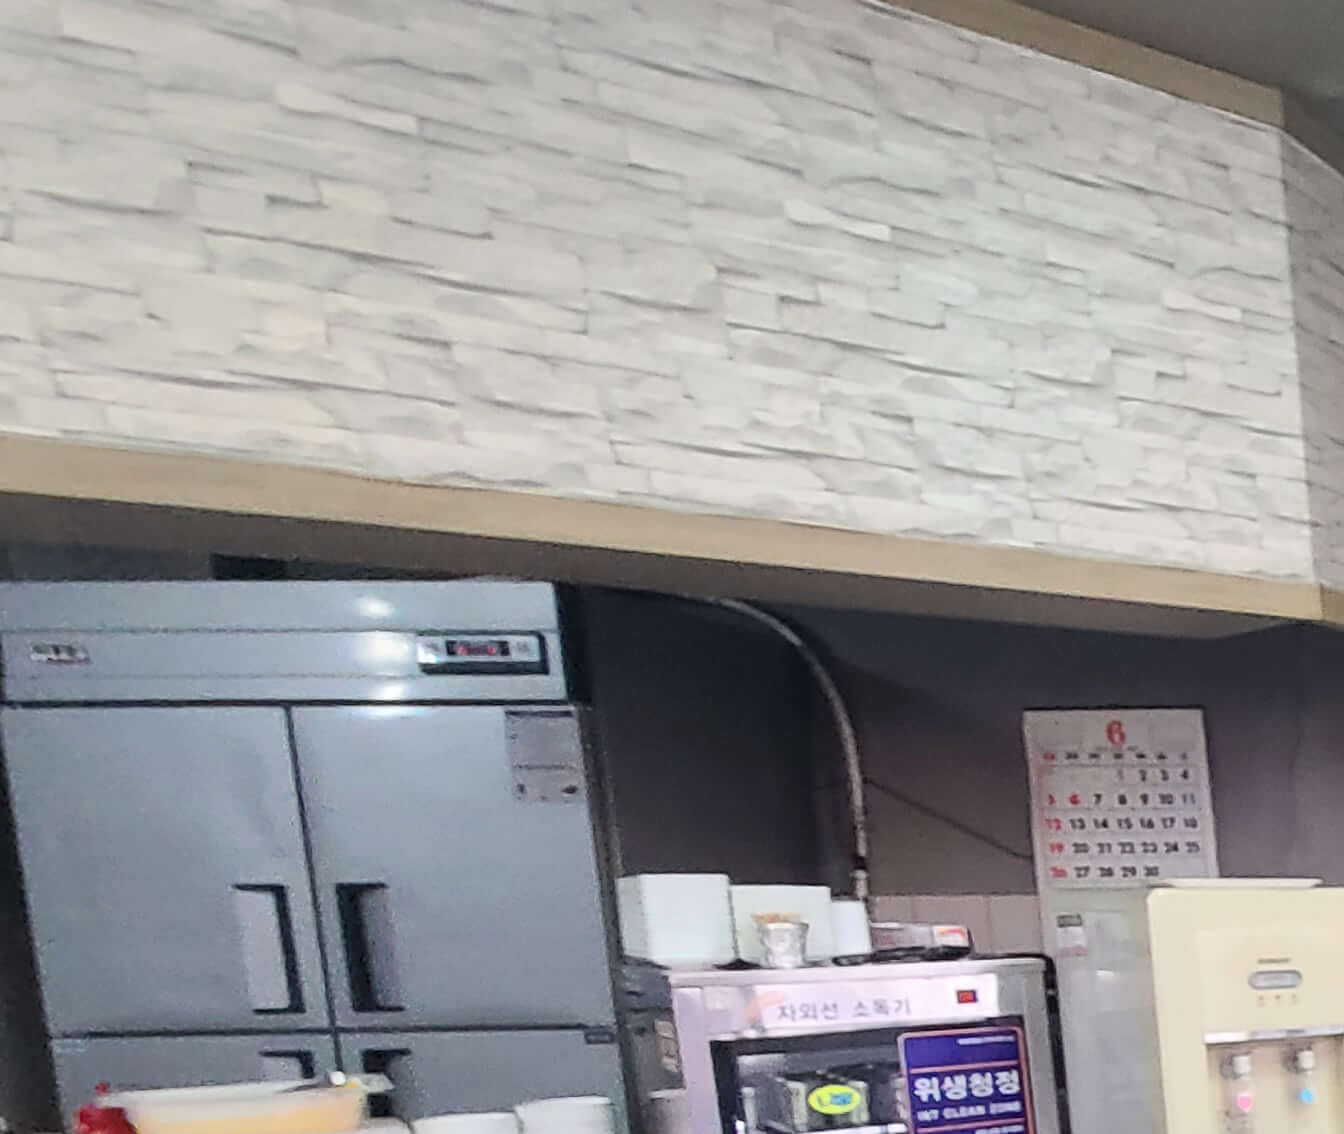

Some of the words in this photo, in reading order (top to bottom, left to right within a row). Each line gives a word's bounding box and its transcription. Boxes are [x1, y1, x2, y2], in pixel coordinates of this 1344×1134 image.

[1105, 719, 1126, 746] 6
[1069, 818, 1086, 830] 13
[1093, 818, 1109, 829] 14
[1117, 818, 1133, 830] 15
[1139, 818, 1155, 830] 16
[1160, 817, 1176, 829] 17
[777, 1001, 840, 1023] 자외선
[852, 999, 912, 1018] 소독기
[913, 1068, 1021, 1103] 위생청정
